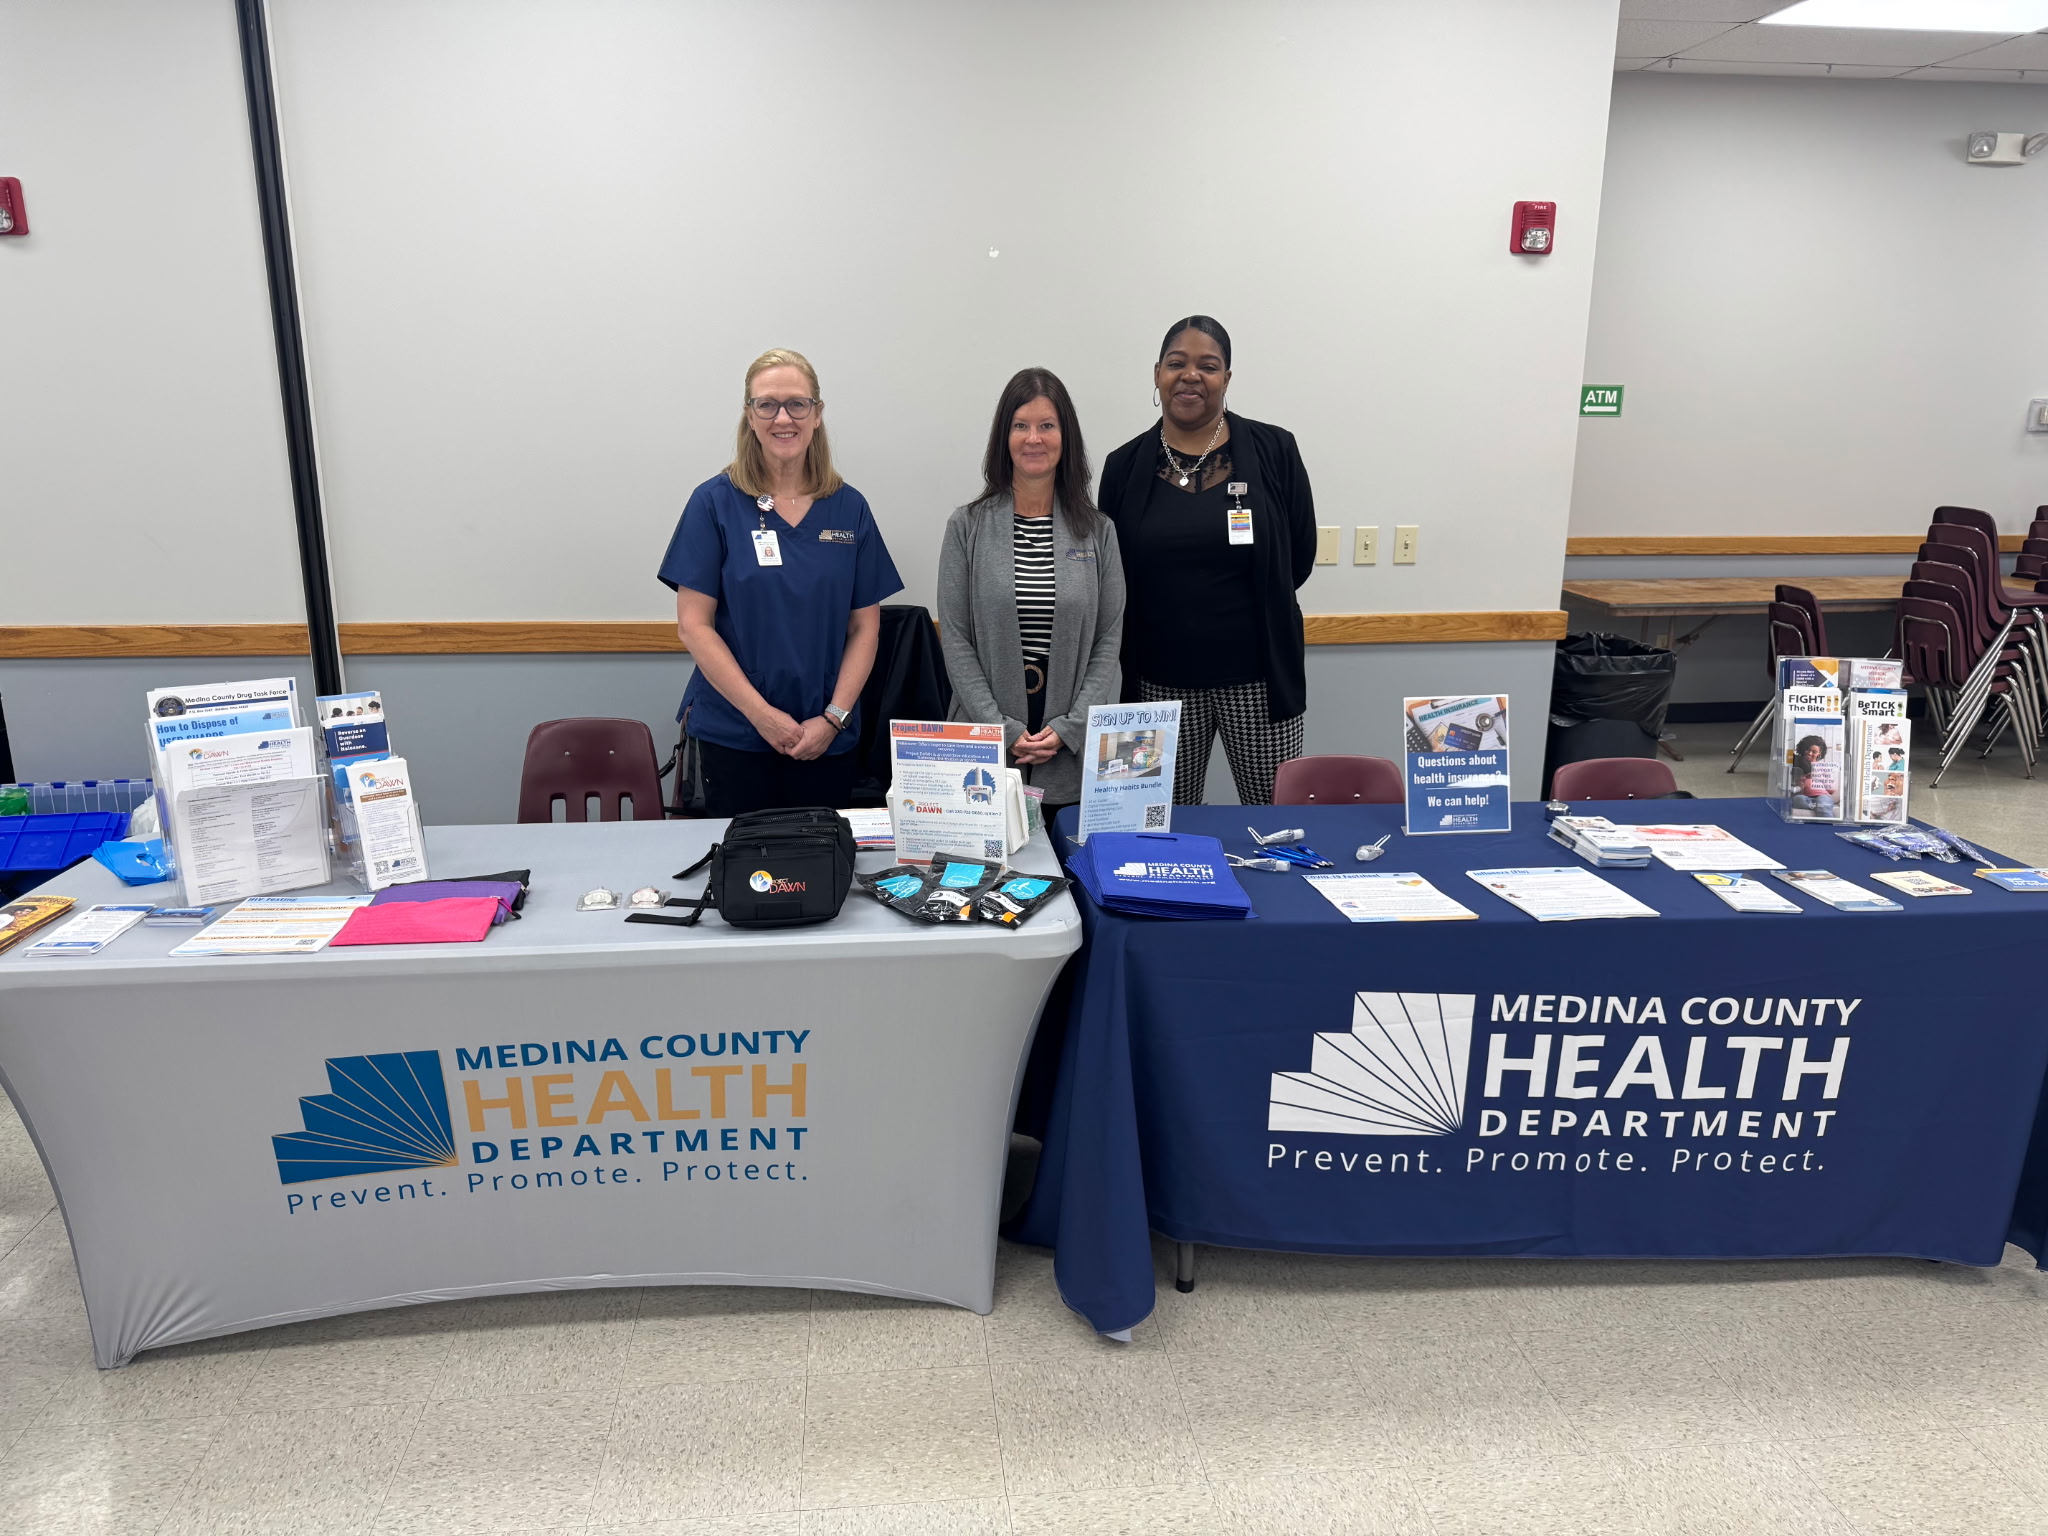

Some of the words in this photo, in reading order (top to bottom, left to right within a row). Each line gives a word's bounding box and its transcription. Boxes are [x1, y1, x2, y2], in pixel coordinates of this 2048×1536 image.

[1585, 390, 1617, 403] ATM
[1788, 695, 1825, 704] FIGHT
[1858, 701, 1895, 709] BeTICK
[1092, 712, 1118, 727] SIGN
[1120, 712, 1135, 725] UP
[1137, 711, 1152, 724] TO
[1154, 708, 1177, 723] WIN!
[1418, 709, 1444, 722] HEALTH
[1443, 700, 1479, 715] INSURANCE
[1862, 708, 1895, 717] Smart
[156, 725, 176, 734] How
[179, 723, 189, 731] to
[191, 719, 227, 730] Dispose
[230, 716, 238, 725] of
[892, 723, 919, 733] Project
[922, 724, 944, 733] DAWN
[1865, 724, 1873, 760] Department
[204, 750, 229, 760] DAWN
[1418, 756, 1466, 769] Questions
[1469, 754, 1497, 766] about
[376, 778, 404, 789] DAWN
[1414, 773, 1445, 785] health
[1448, 770, 1502, 784] insur?
[1095, 786, 1118, 794] Healthy
[1428, 796, 1442, 807] We
[1445, 798, 1462, 807] can
[1464, 794, 1489, 808] help!
[916, 806, 943, 814] DAWN
[1149, 867, 1214, 876] HEALTH
[770, 882, 806, 894] DAWN
[1490, 994, 1667, 1024] MEDINA
[1681, 997, 1862, 1025] COUNTY
[456, 1038, 629, 1070] MEDINA
[640, 1030, 811, 1058] COUNTY
[1484, 1033, 1850, 1100] HEALTH
[463, 1063, 807, 1132] HEALTH
[1479, 1110, 1836, 1138] DEPARTMENT
[472, 1128, 808, 1163] DEPARTMENT
[1268, 1143, 1442, 1173] Prevent.
[1466, 1148, 1647, 1173] Promote.
[1672, 1149, 1824, 1173] Protect.
[287, 1179, 447, 1214] Prevent.
[467, 1167, 641, 1193] Promote.
[663, 1161, 807, 1181] Protect.
